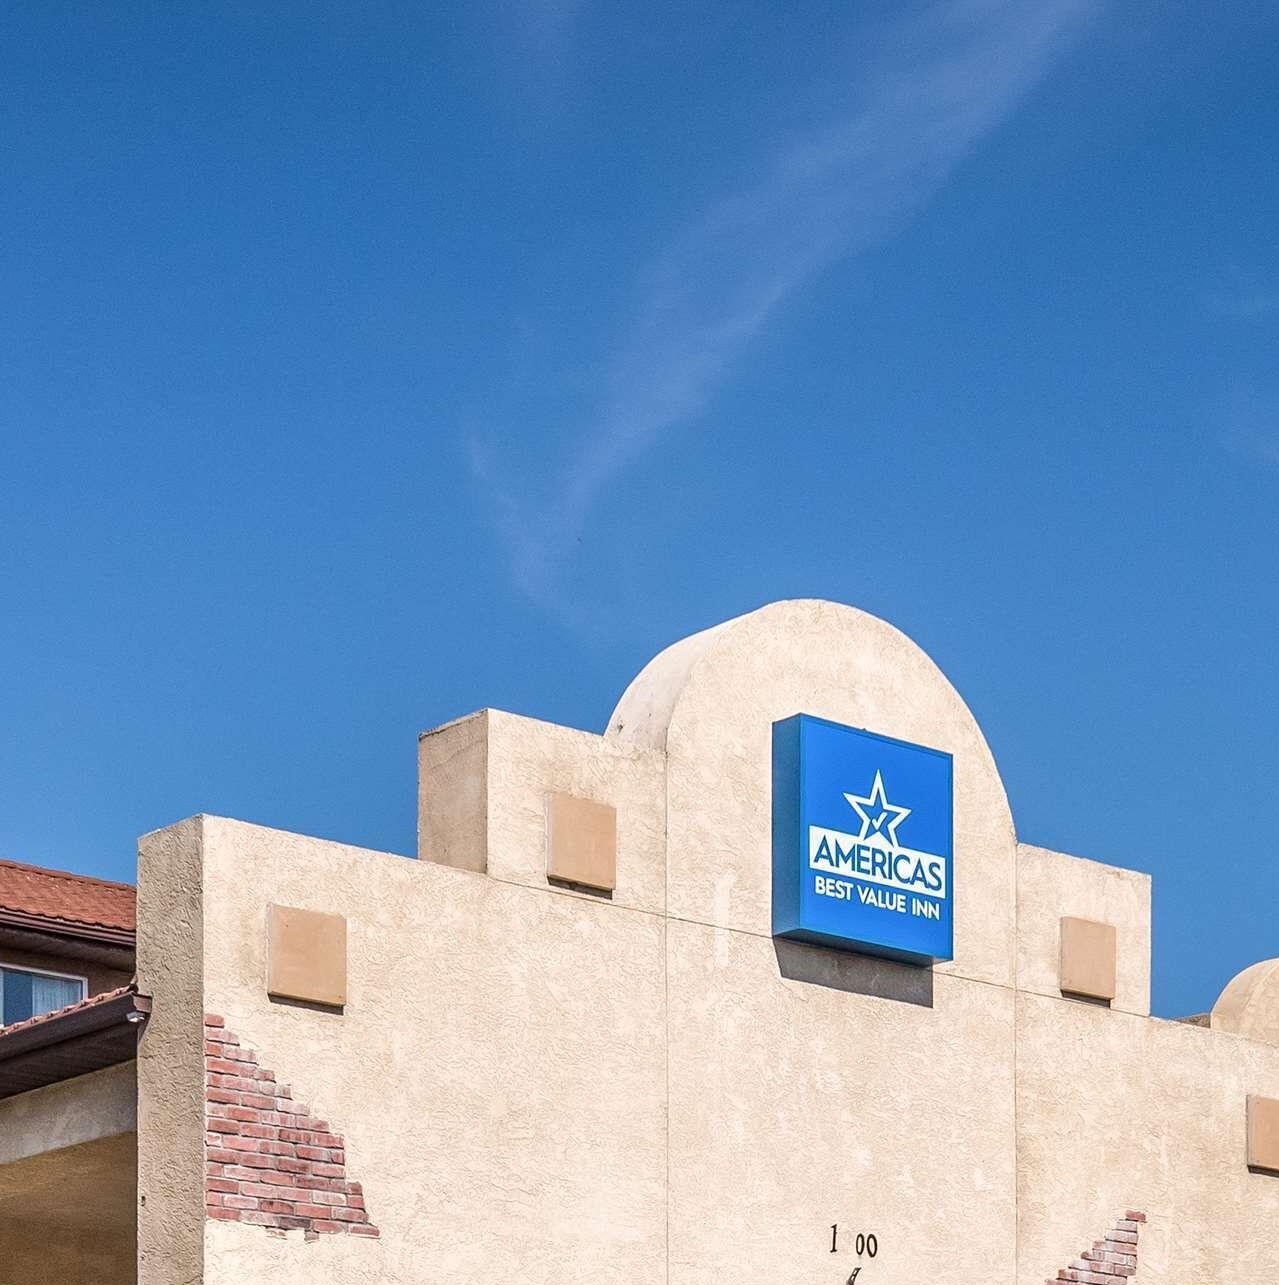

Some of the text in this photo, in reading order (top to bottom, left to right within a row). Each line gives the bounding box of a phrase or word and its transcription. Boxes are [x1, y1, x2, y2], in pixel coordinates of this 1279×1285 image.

[813, 834, 942, 891] AMERICAS
[815, 875, 940, 921] BEST VALUE INN
